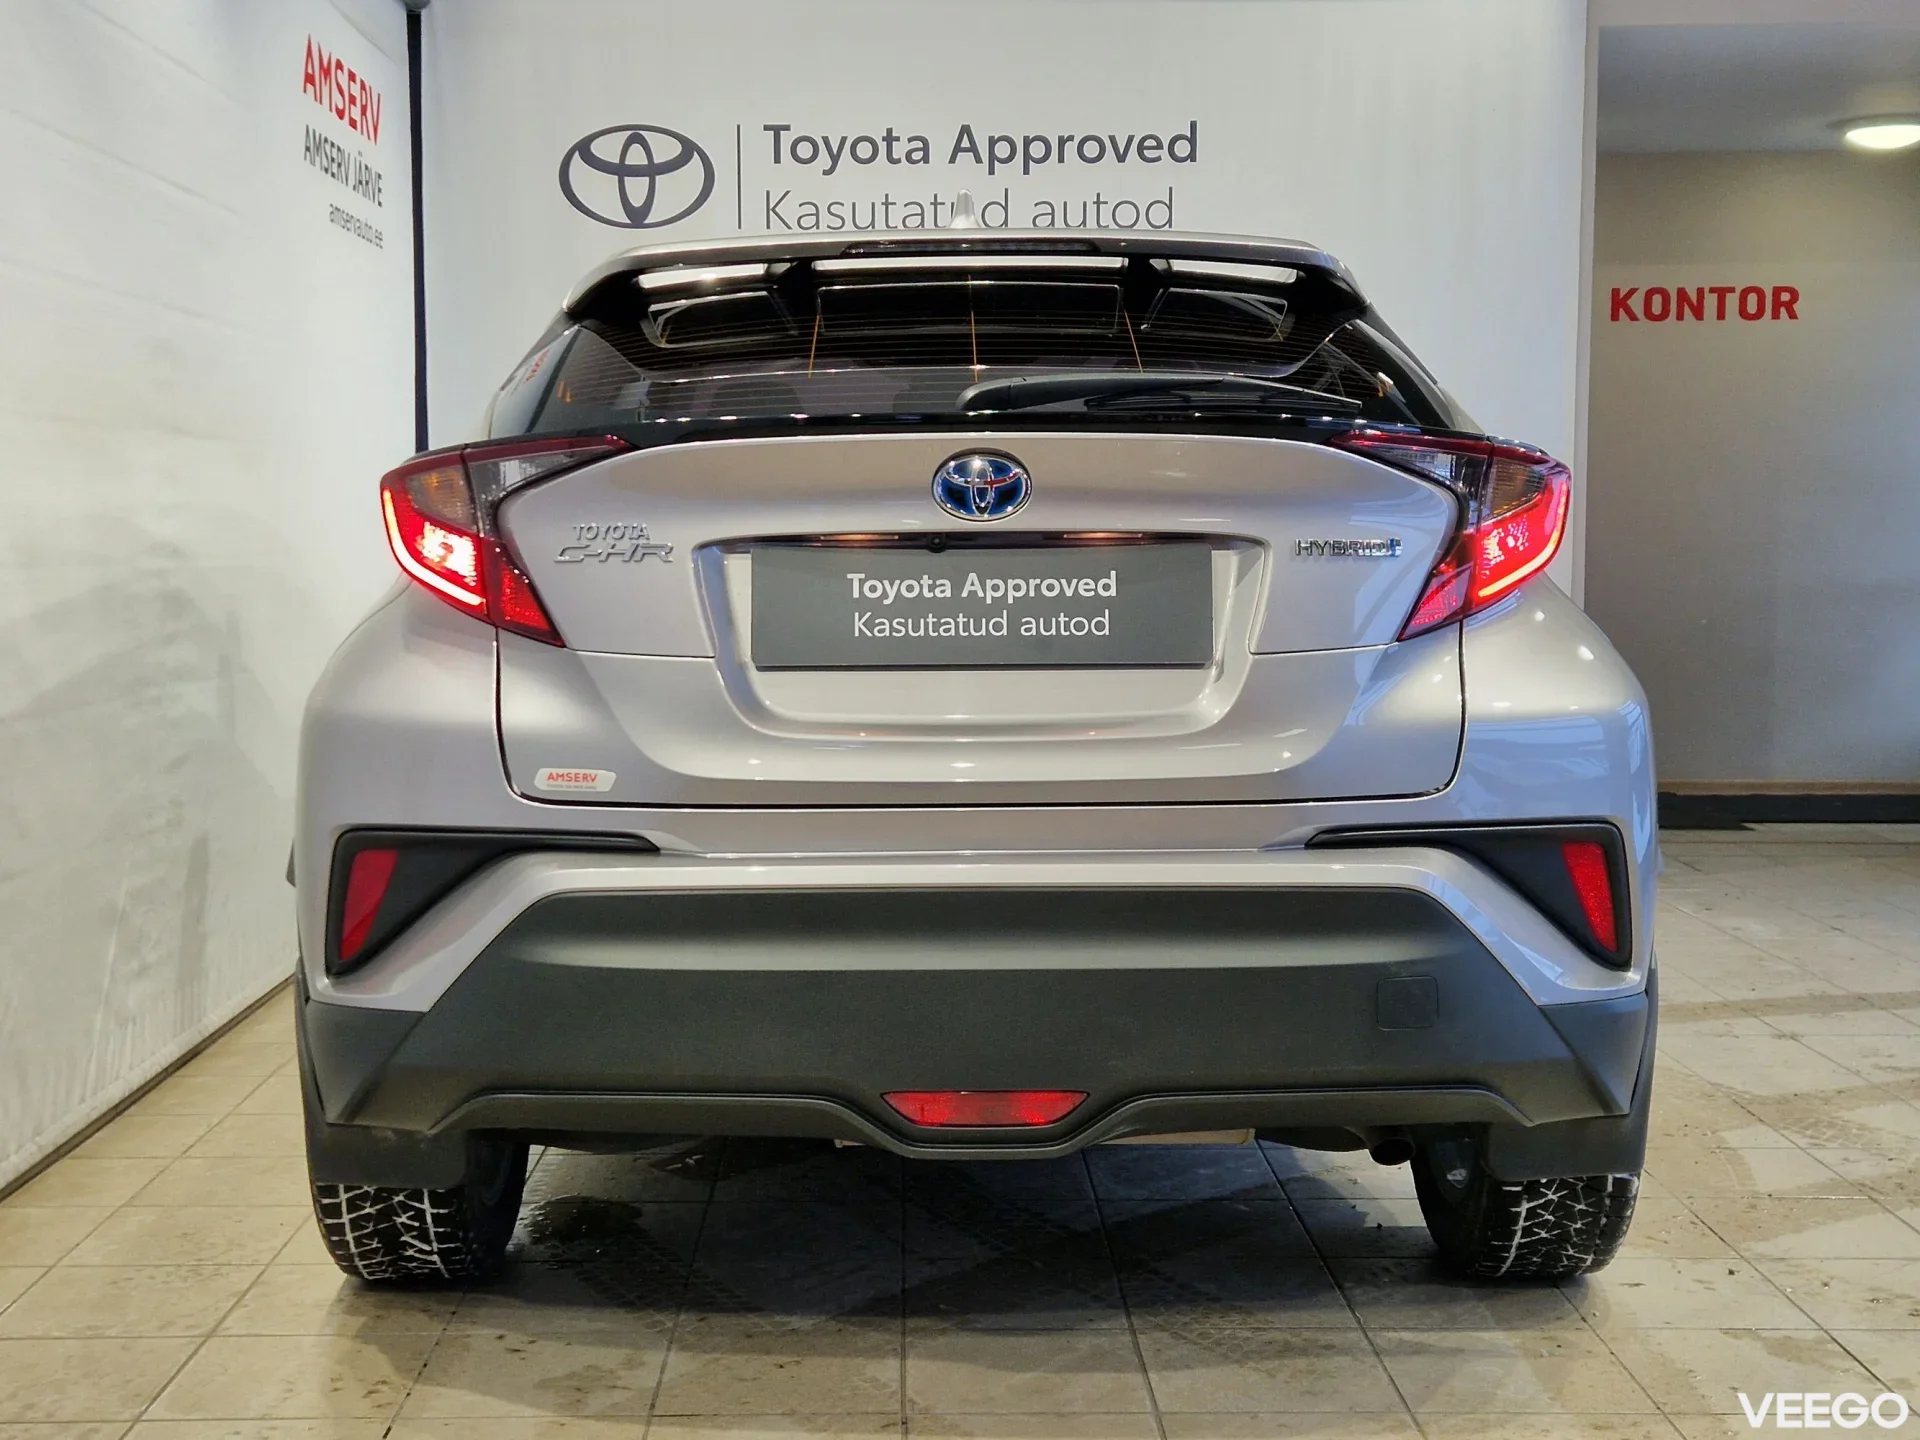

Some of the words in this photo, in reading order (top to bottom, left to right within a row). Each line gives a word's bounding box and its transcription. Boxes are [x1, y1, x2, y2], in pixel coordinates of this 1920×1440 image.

[303, 33, 381, 145] AMSERV
[304, 123, 351, 187] AMSERV
[352, 150, 383, 208] JÄRVE
[763, 124, 930, 176] Toyota
[948, 120, 1197, 175] Approved
[765, 189, 1009, 230] Kasutatd
[1031, 186, 1173, 230] autod
[329, 203, 383, 249] amservauto.ee
[1610, 286, 1799, 322] KONTOR
[573, 522, 651, 541] TOYOTA
[1295, 538, 1387, 557] HYBRID
[554, 543, 674, 563] C-HR
[847, 573, 952, 604] Toyota
[961, 570, 1117, 604] Approved
[854, 610, 1008, 637] Kasutatud
[1020, 608, 1110, 636] autod
[547, 772, 598, 783] AMSERV
